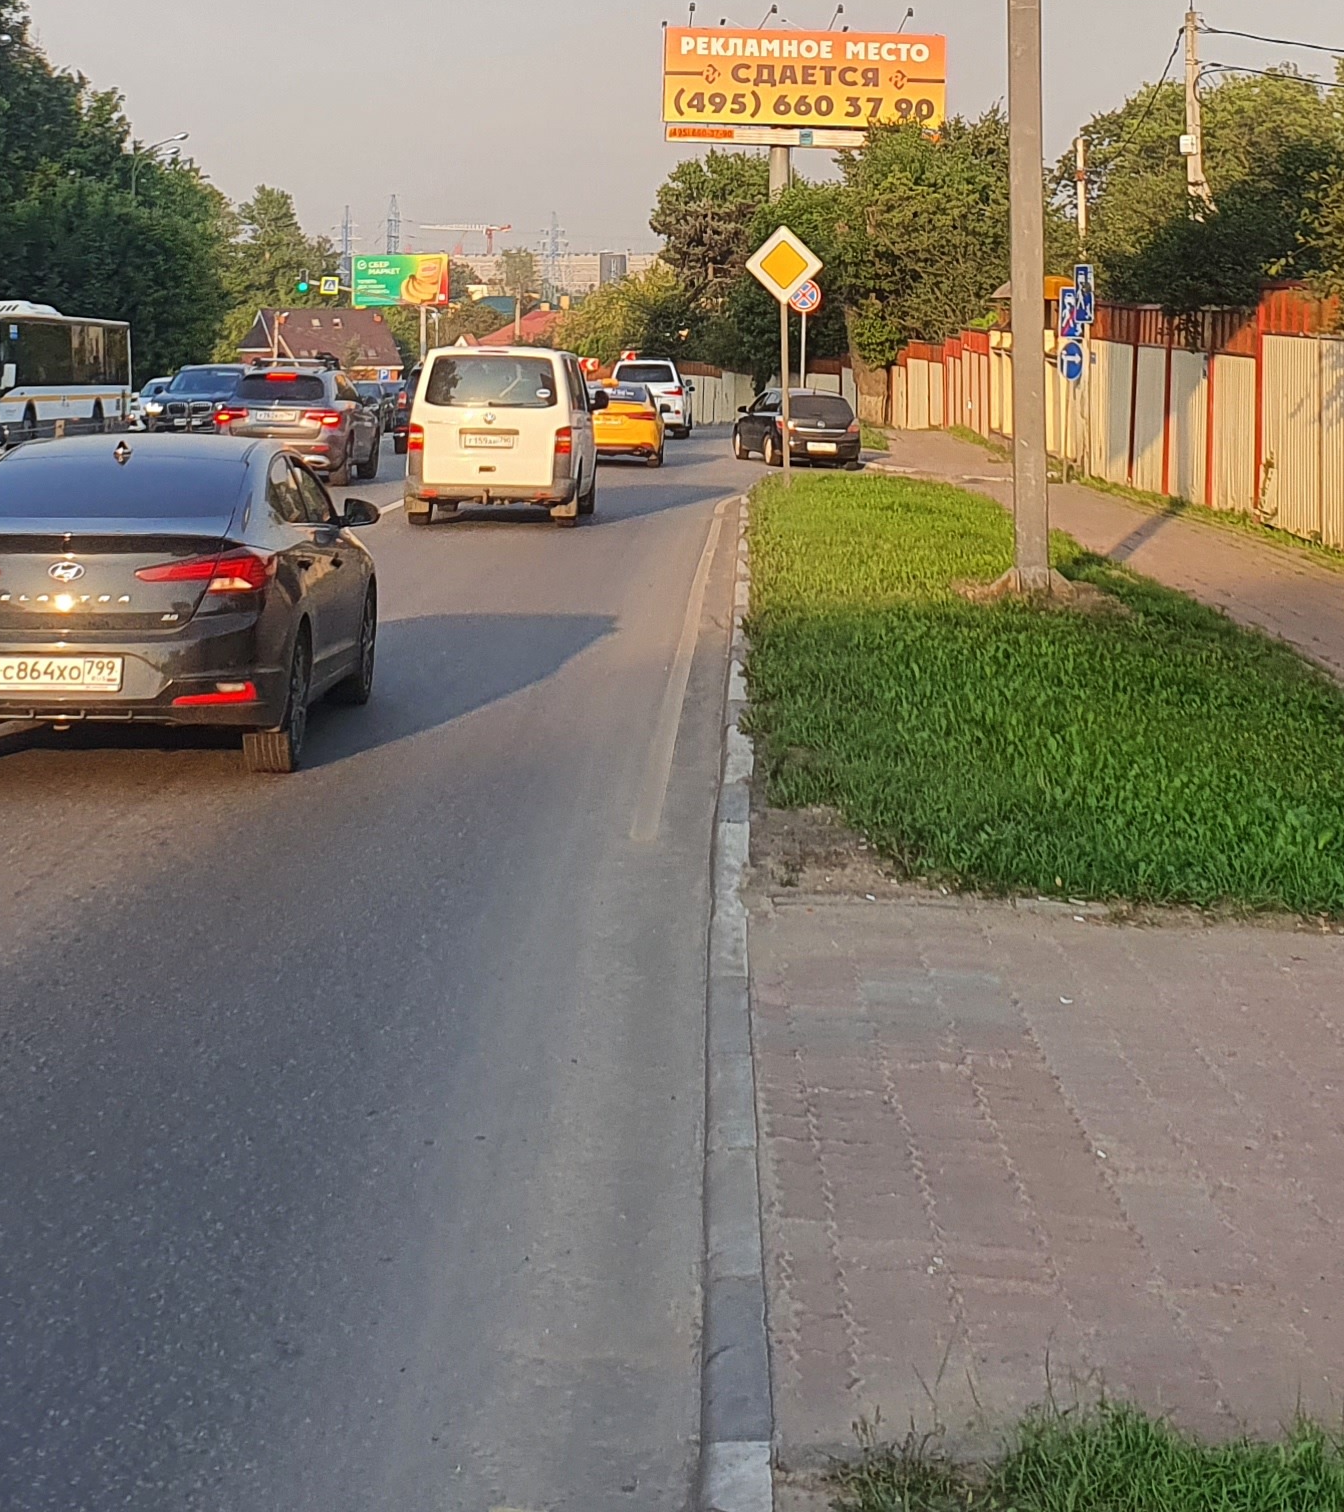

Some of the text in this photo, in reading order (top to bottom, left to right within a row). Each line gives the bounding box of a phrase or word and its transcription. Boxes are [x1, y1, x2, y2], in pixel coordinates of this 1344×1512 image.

[680, 36, 930, 62] РЕКЛАМНОЕ МЕСТО
[730, 63, 880, 87] СДАЕТСЯ
[673, 87, 935, 120] (495) 660 37 90
[0, 594, 131, 603] ELATRA
[2, 660, 116, 681] С864ХО 799
